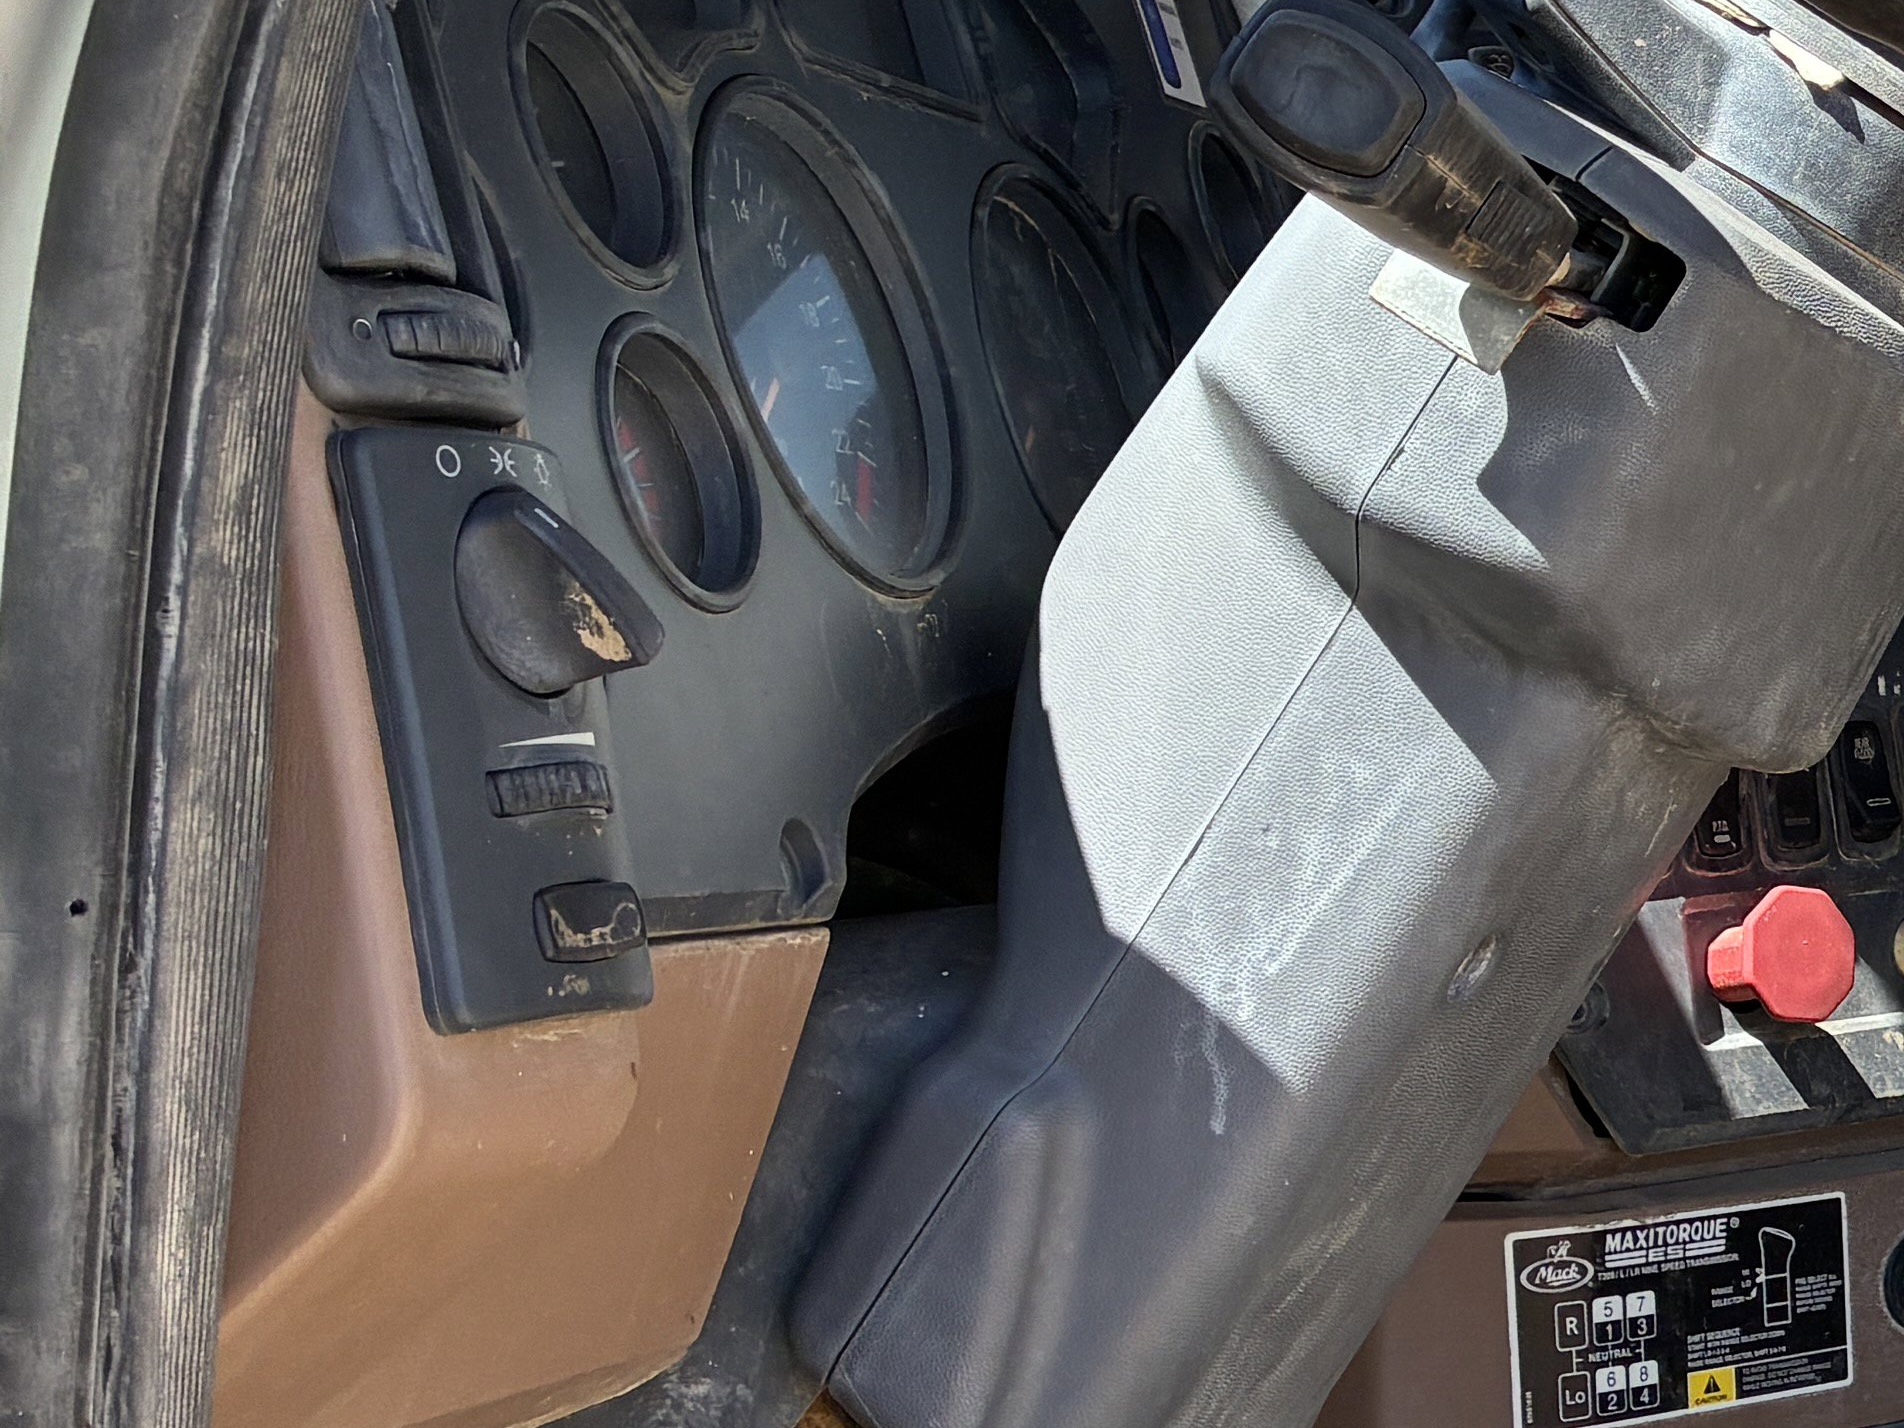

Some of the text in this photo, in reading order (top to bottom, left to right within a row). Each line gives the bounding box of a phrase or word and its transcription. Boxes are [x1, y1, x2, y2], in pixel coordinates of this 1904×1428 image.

[1647, 1243, 1685, 1263] ES
[1534, 1262, 1582, 1286] Mack
[1603, 1301, 1614, 1318] 5
[1636, 1296, 1646, 1313] 7
[1565, 1316, 1579, 1336] R
[1605, 1323, 1613, 1341] 1
[1637, 1318, 1648, 1335] 3
[1588, 1346, 1633, 1363] NEUTRAL
[1607, 1371, 1617, 1388] 6
[1640, 1365, 1649, 1382] 8
[1607, 1394, 1618, 1410] 2
[1639, 1387, 1650, 1404] 4
